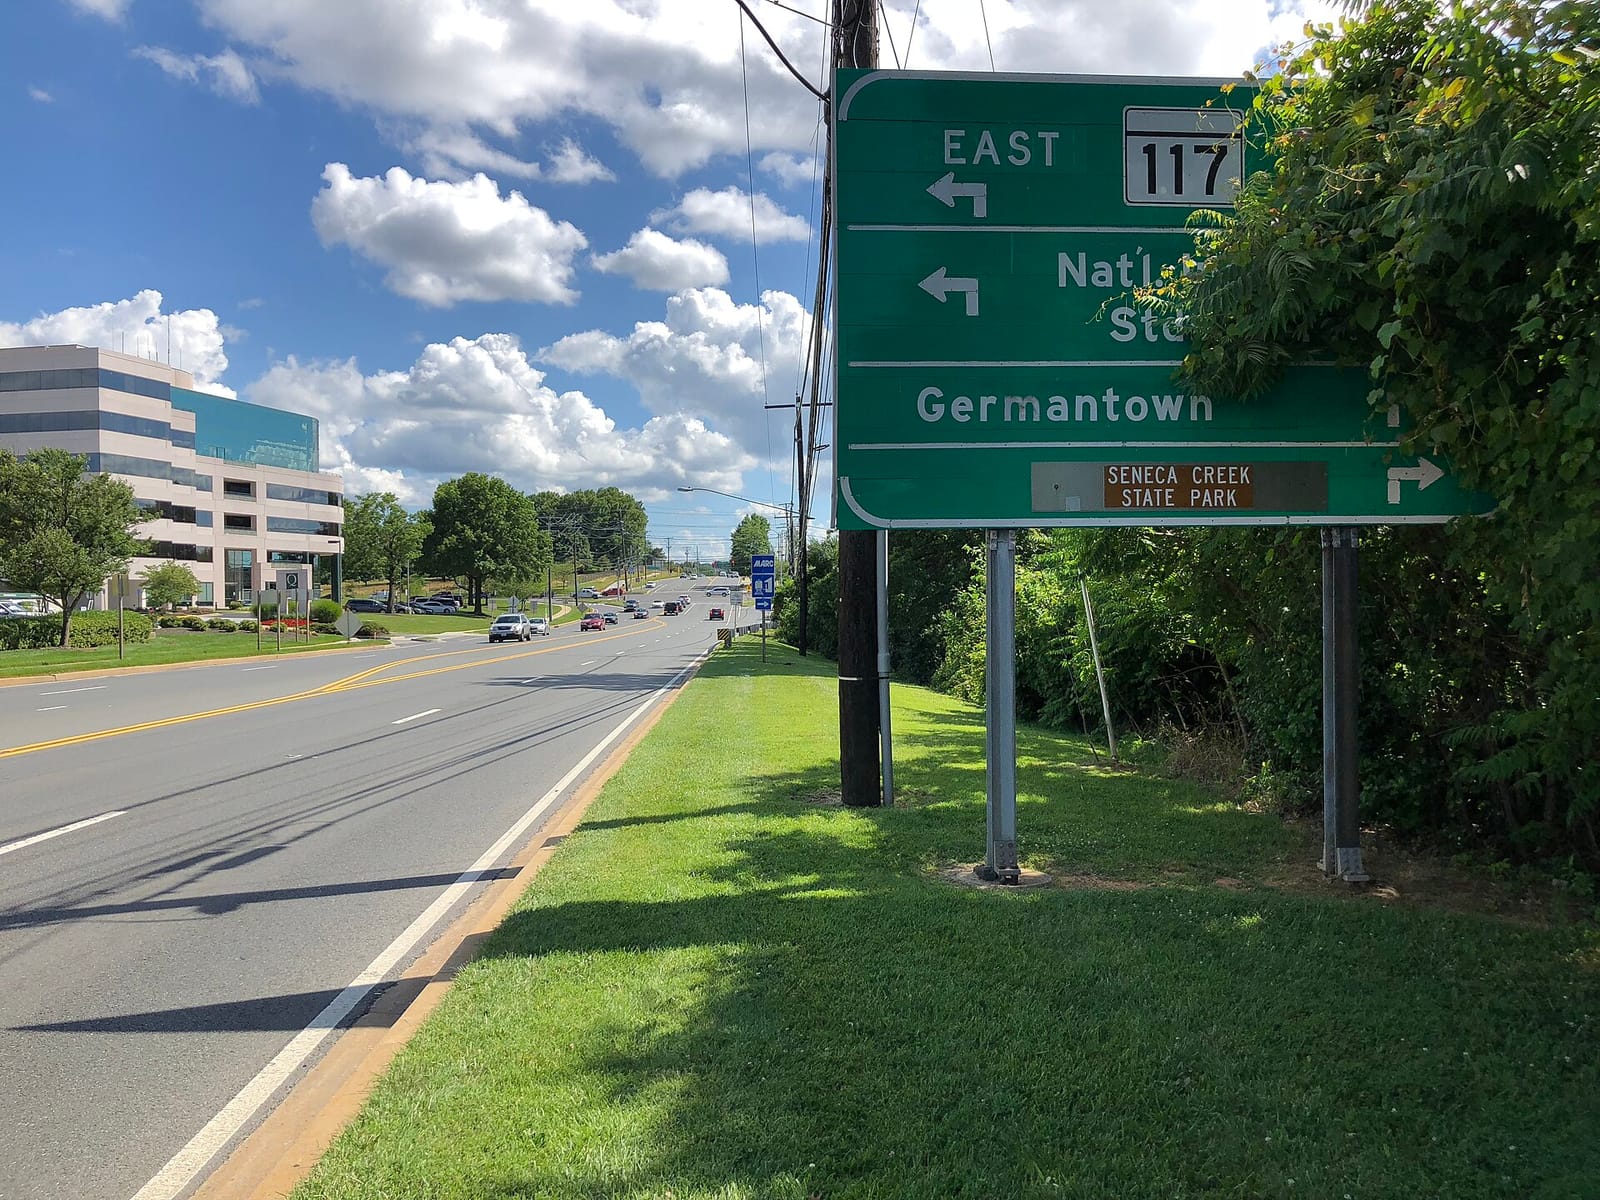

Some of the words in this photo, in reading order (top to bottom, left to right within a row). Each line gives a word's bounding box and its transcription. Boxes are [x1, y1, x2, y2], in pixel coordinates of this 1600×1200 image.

[943, 129, 1060, 167] EAST
[1141, 143, 1228, 196] 117
[916, 386, 1213, 422] Germantown
[1107, 466, 1178, 485] SENECA
[1192, 465, 1251, 484] CREEK
[1121, 488, 1175, 507] STATE
[1190, 488, 1237, 506] PARK
